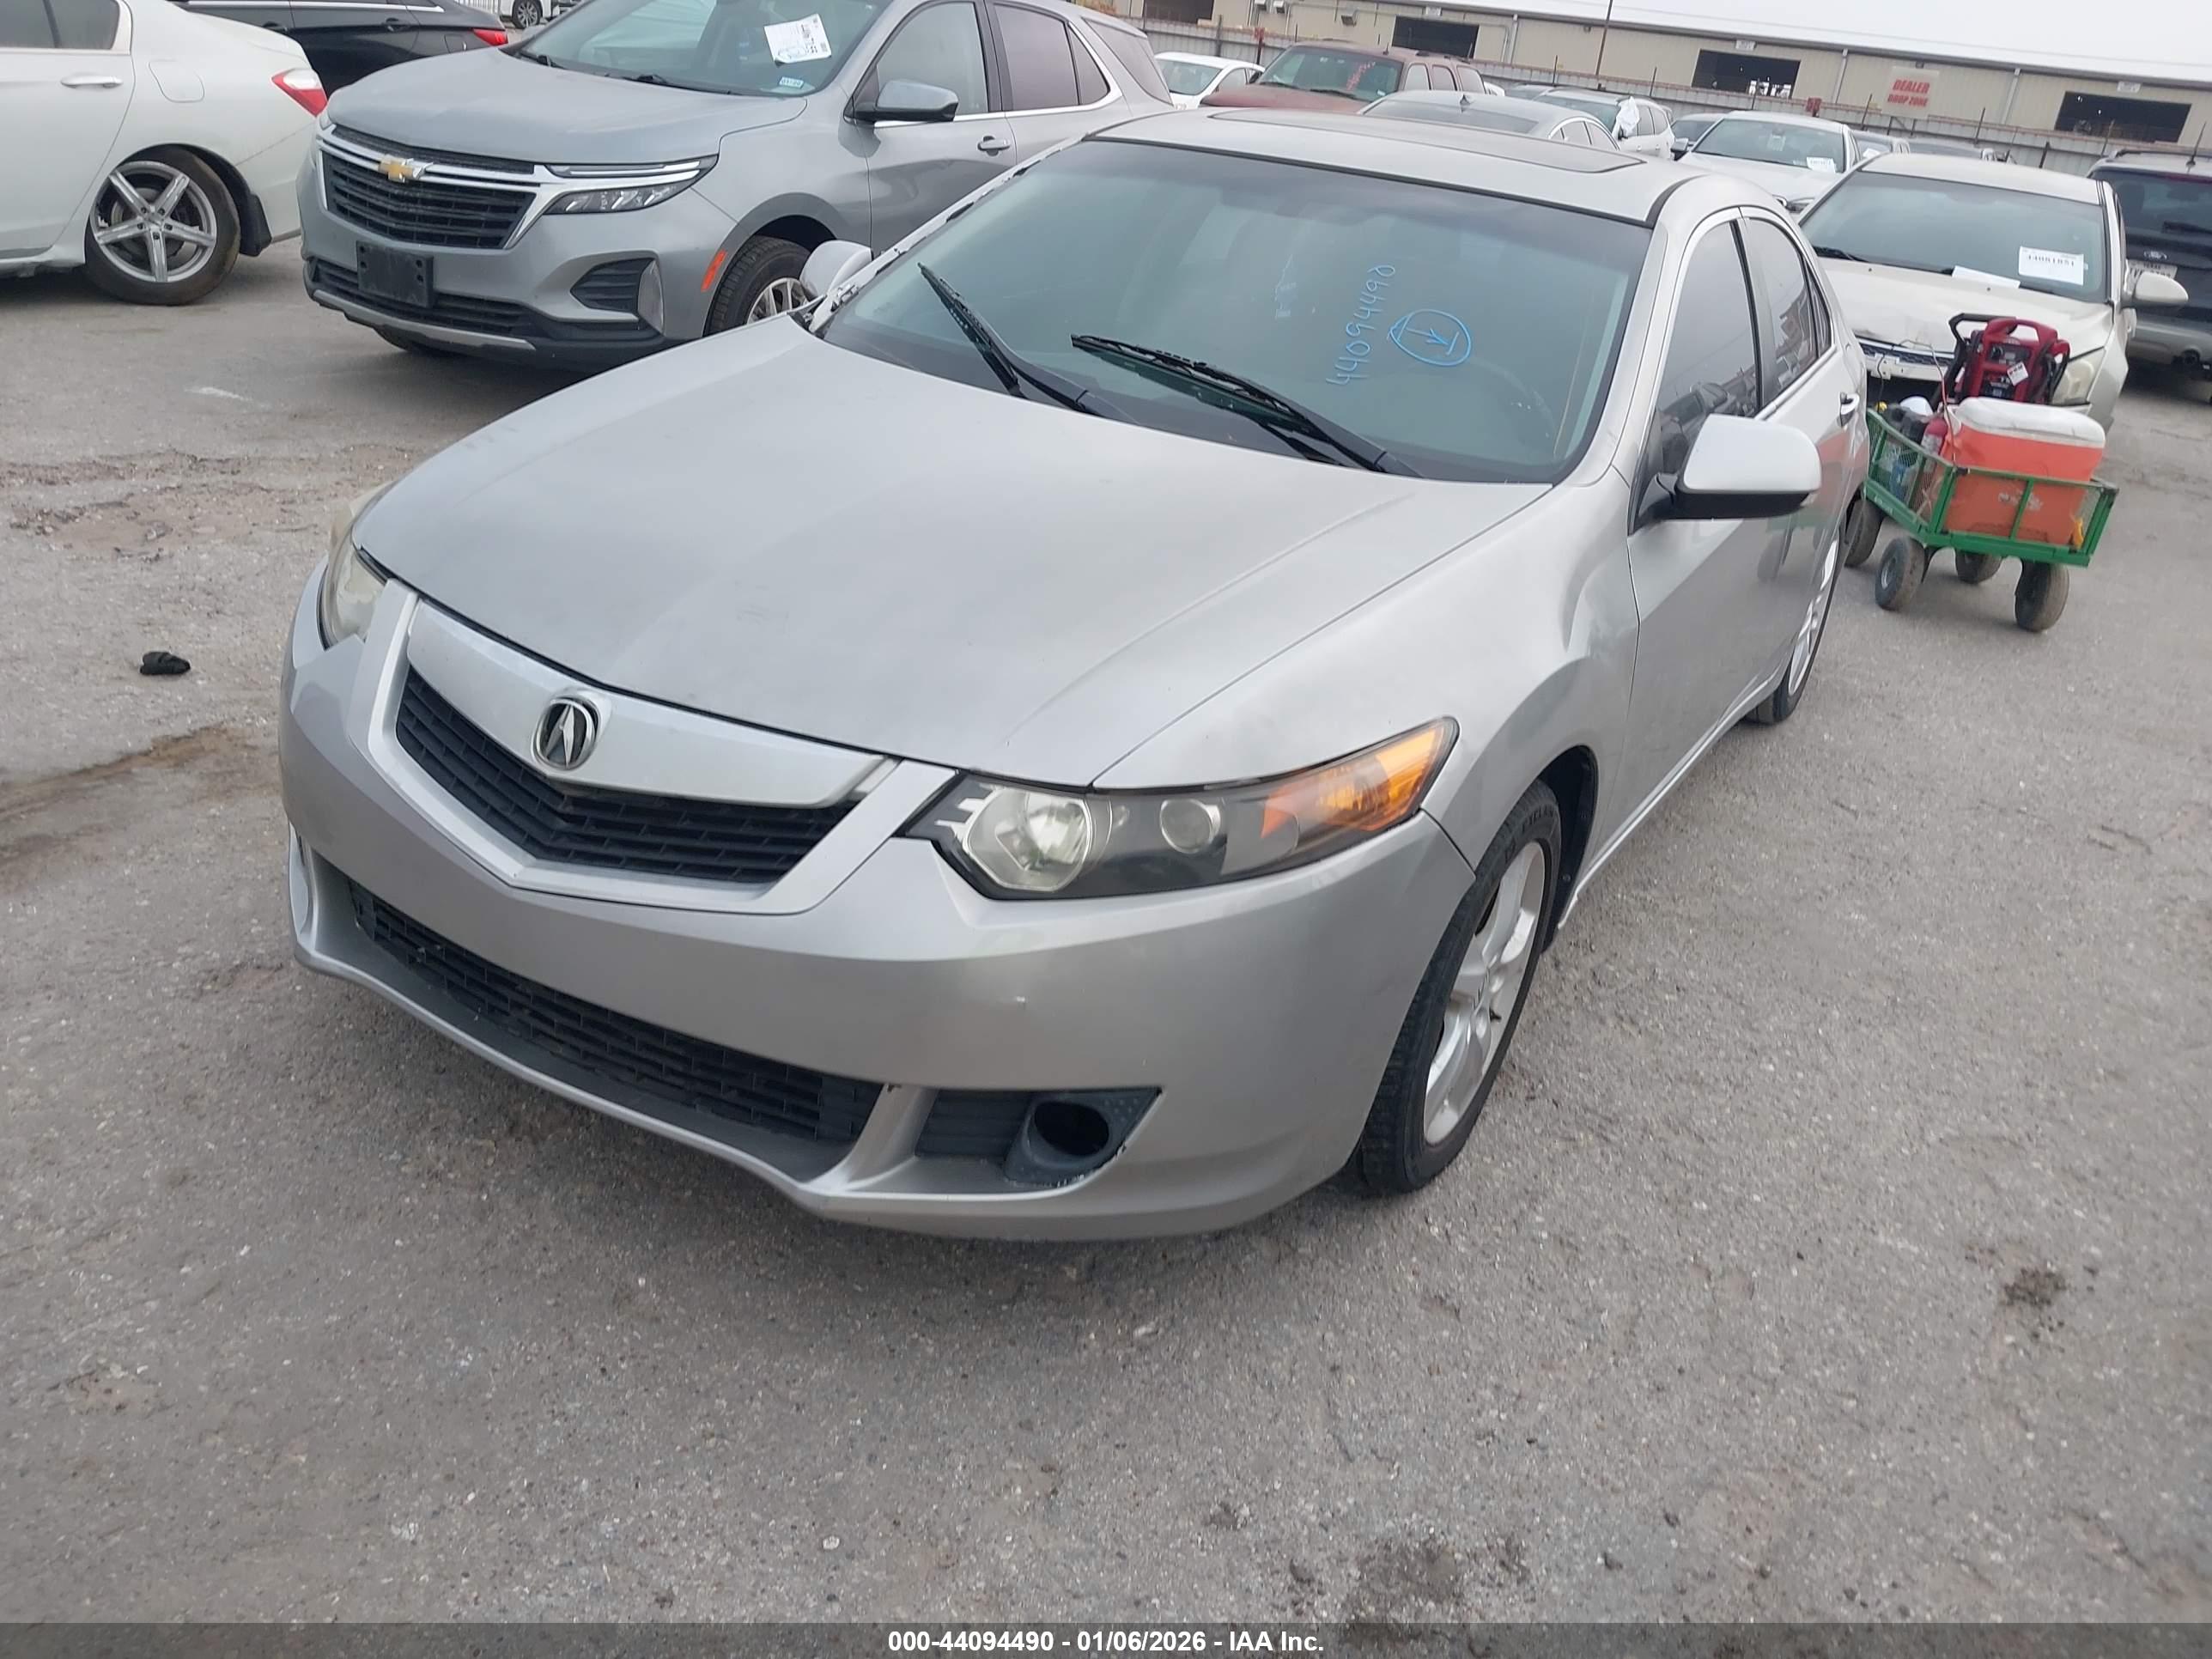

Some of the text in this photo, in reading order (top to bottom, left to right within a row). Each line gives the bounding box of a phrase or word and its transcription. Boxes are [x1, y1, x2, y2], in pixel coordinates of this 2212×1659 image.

[1893, 79, 1929, 94] DEALER
[1887, 94, 1929, 107] DROP ZONE
[1326, 264, 1395, 386] 44094490
